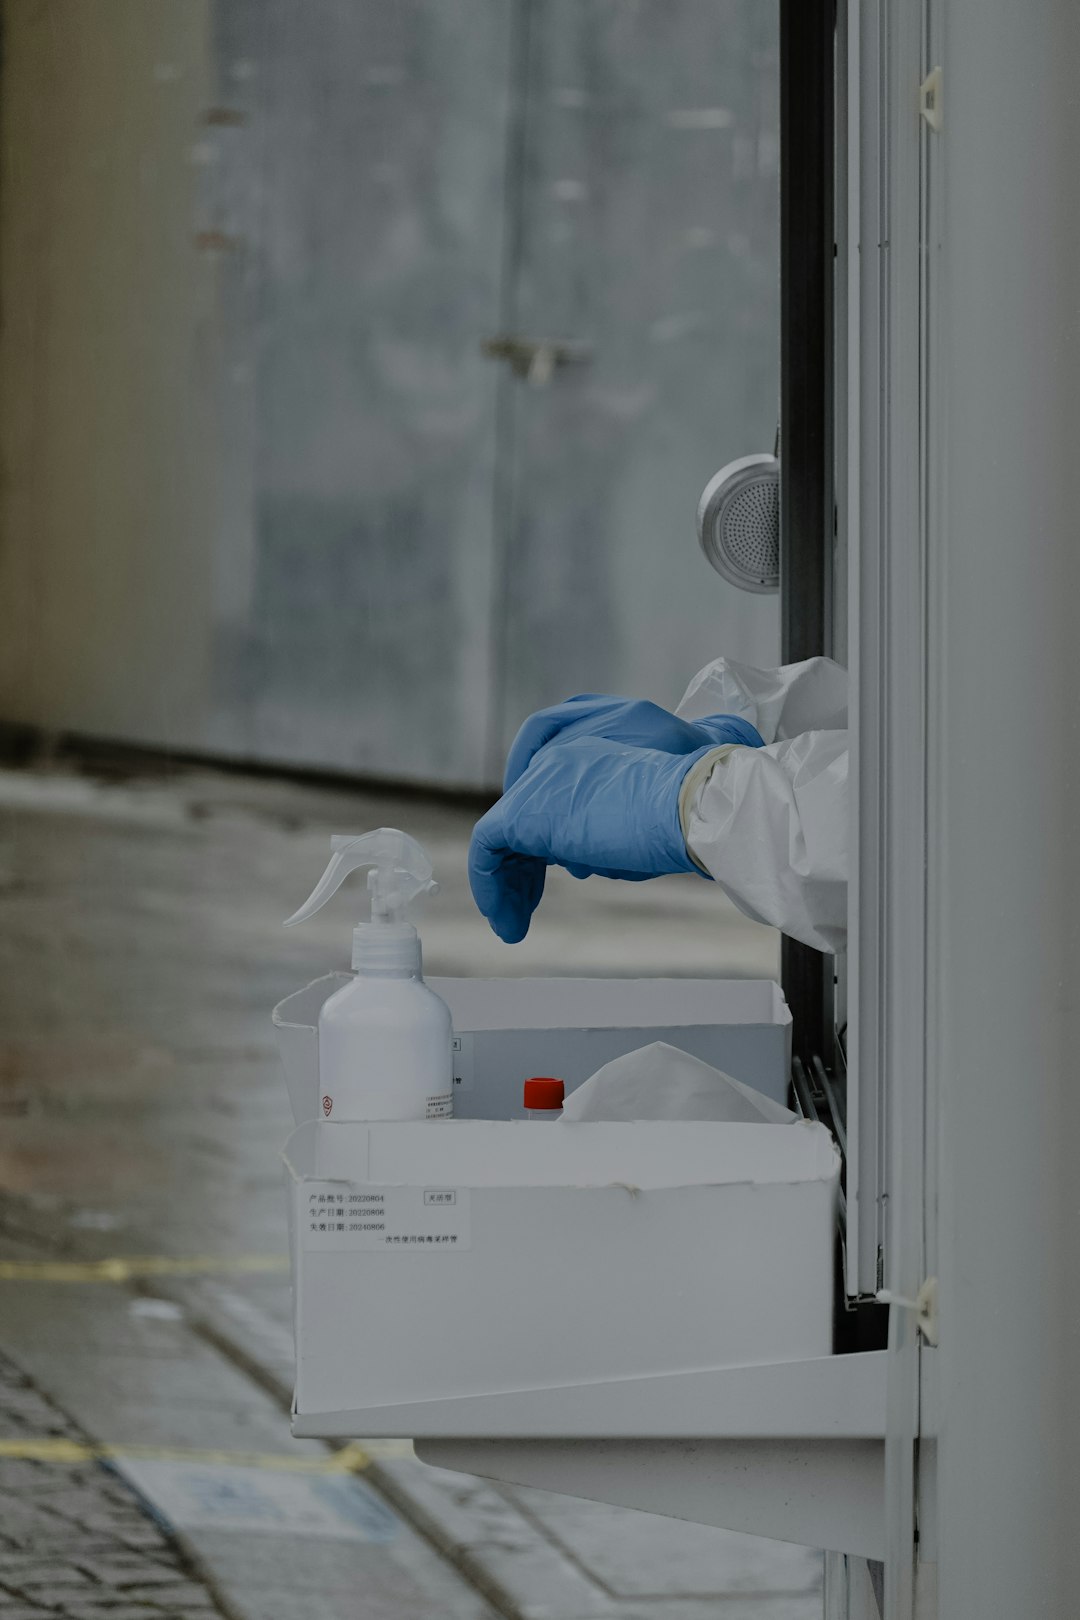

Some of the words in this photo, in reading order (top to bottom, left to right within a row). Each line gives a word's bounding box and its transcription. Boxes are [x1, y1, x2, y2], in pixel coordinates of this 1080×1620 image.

[309, 1194, 384, 1203] 产品批号:20220804
[309, 1208, 385, 1217] 生产日期:20220806
[310, 1223, 385, 1232] 失效日期:20240806
[377, 1235, 458, 1244] 一次性使用病毒采样管
